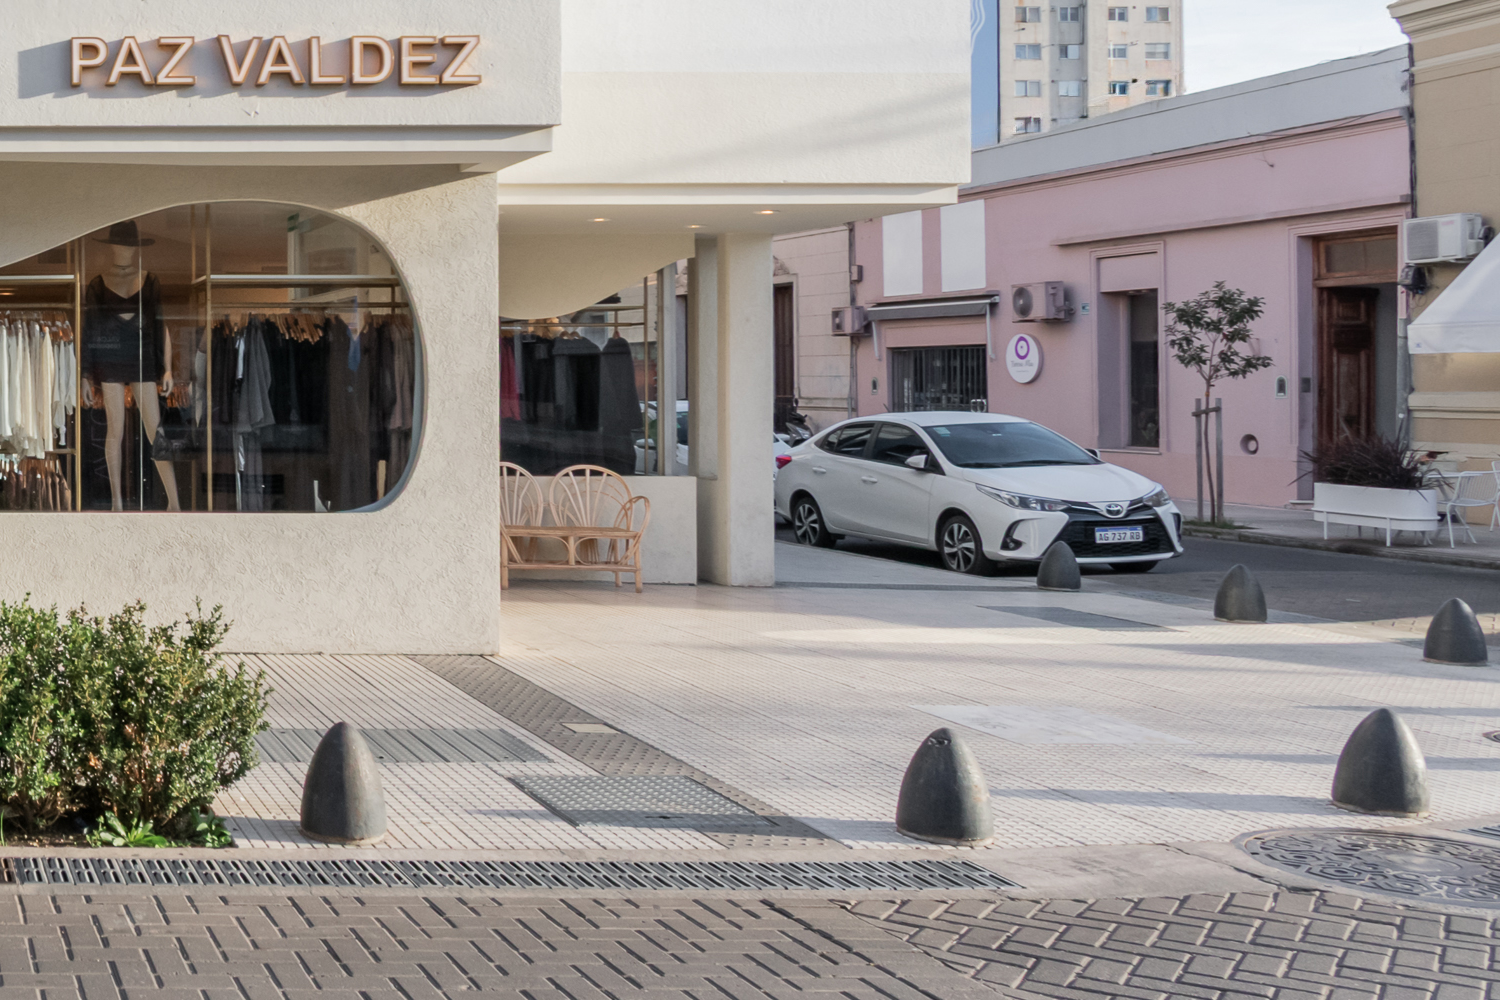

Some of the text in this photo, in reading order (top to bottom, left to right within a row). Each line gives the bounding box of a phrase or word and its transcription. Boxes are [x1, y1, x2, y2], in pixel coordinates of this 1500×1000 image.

[70, 34, 483, 87] PAZ VALDEZ
[1098, 532, 1110, 542] AG
[1111, 531, 1128, 541] 737
